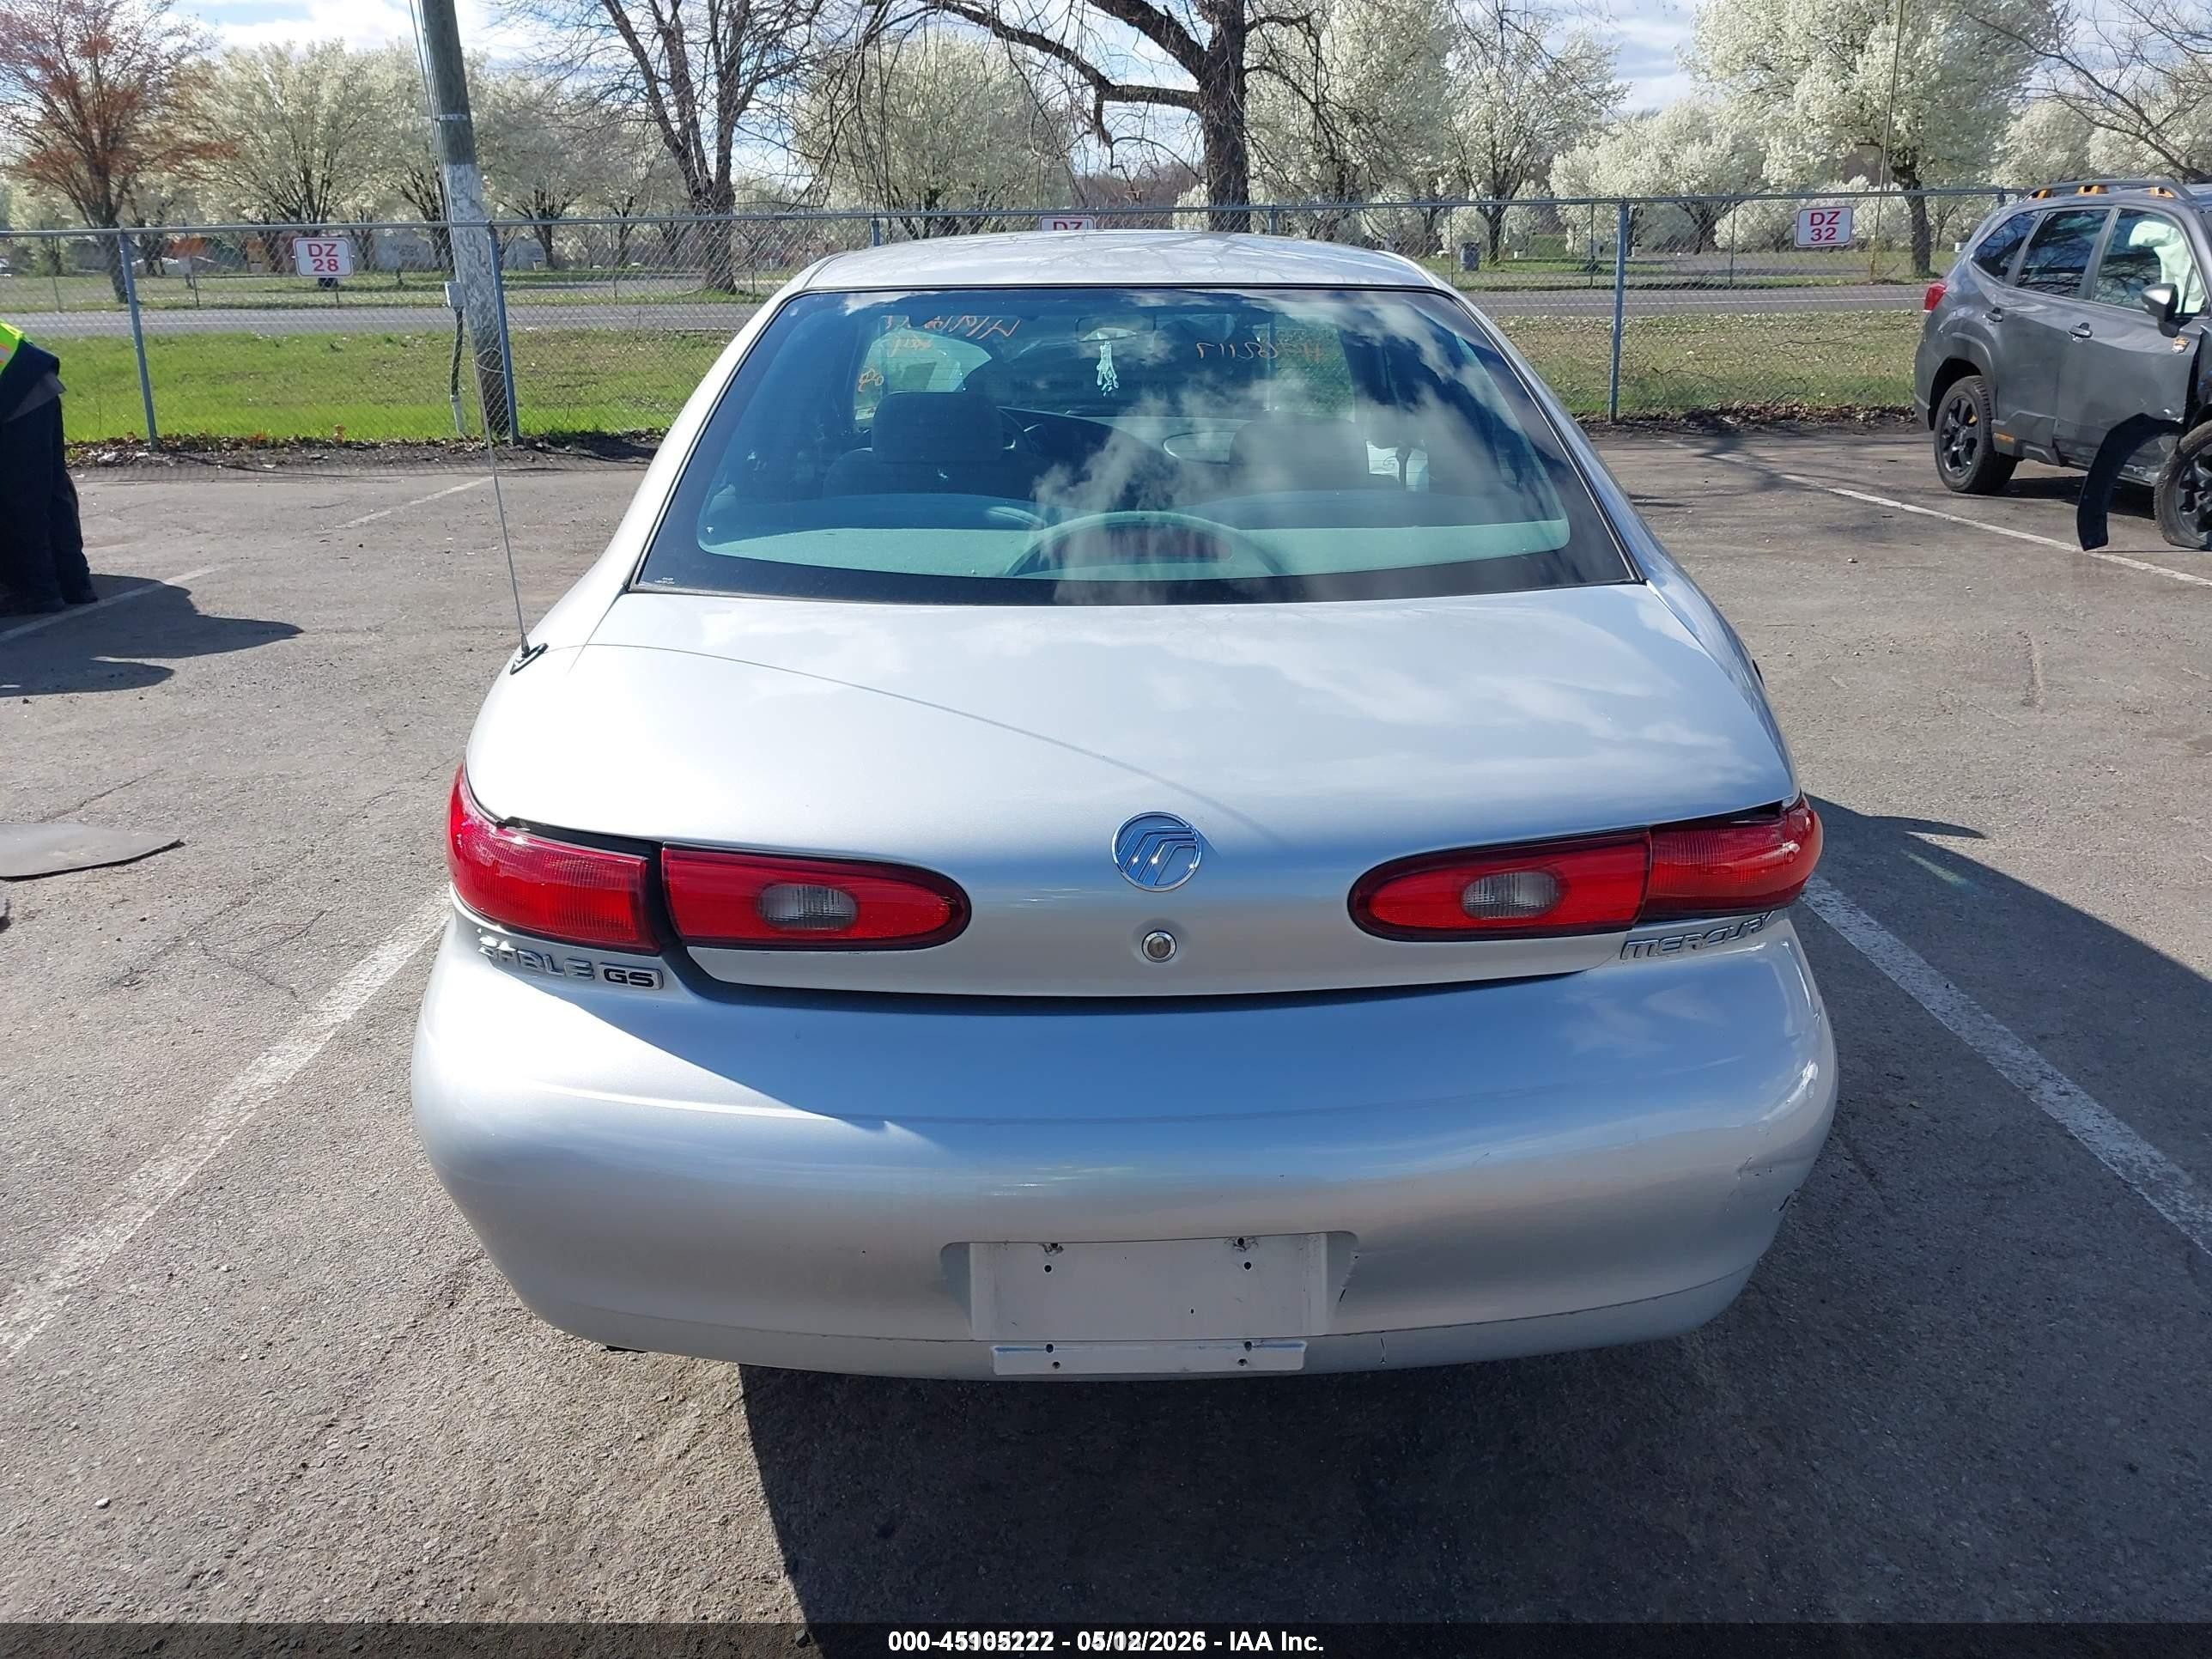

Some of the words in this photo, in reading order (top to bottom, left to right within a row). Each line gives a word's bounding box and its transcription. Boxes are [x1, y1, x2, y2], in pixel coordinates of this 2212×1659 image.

[1053, 221, 1084, 230] DZ
[1809, 210, 1841, 227] DZ
[1810, 227, 1837, 241] 32
[307, 243, 338, 258] DZ
[312, 258, 339, 272] 28
[1620, 910, 1775, 960] MERCURY
[602, 966, 656, 988] GS
